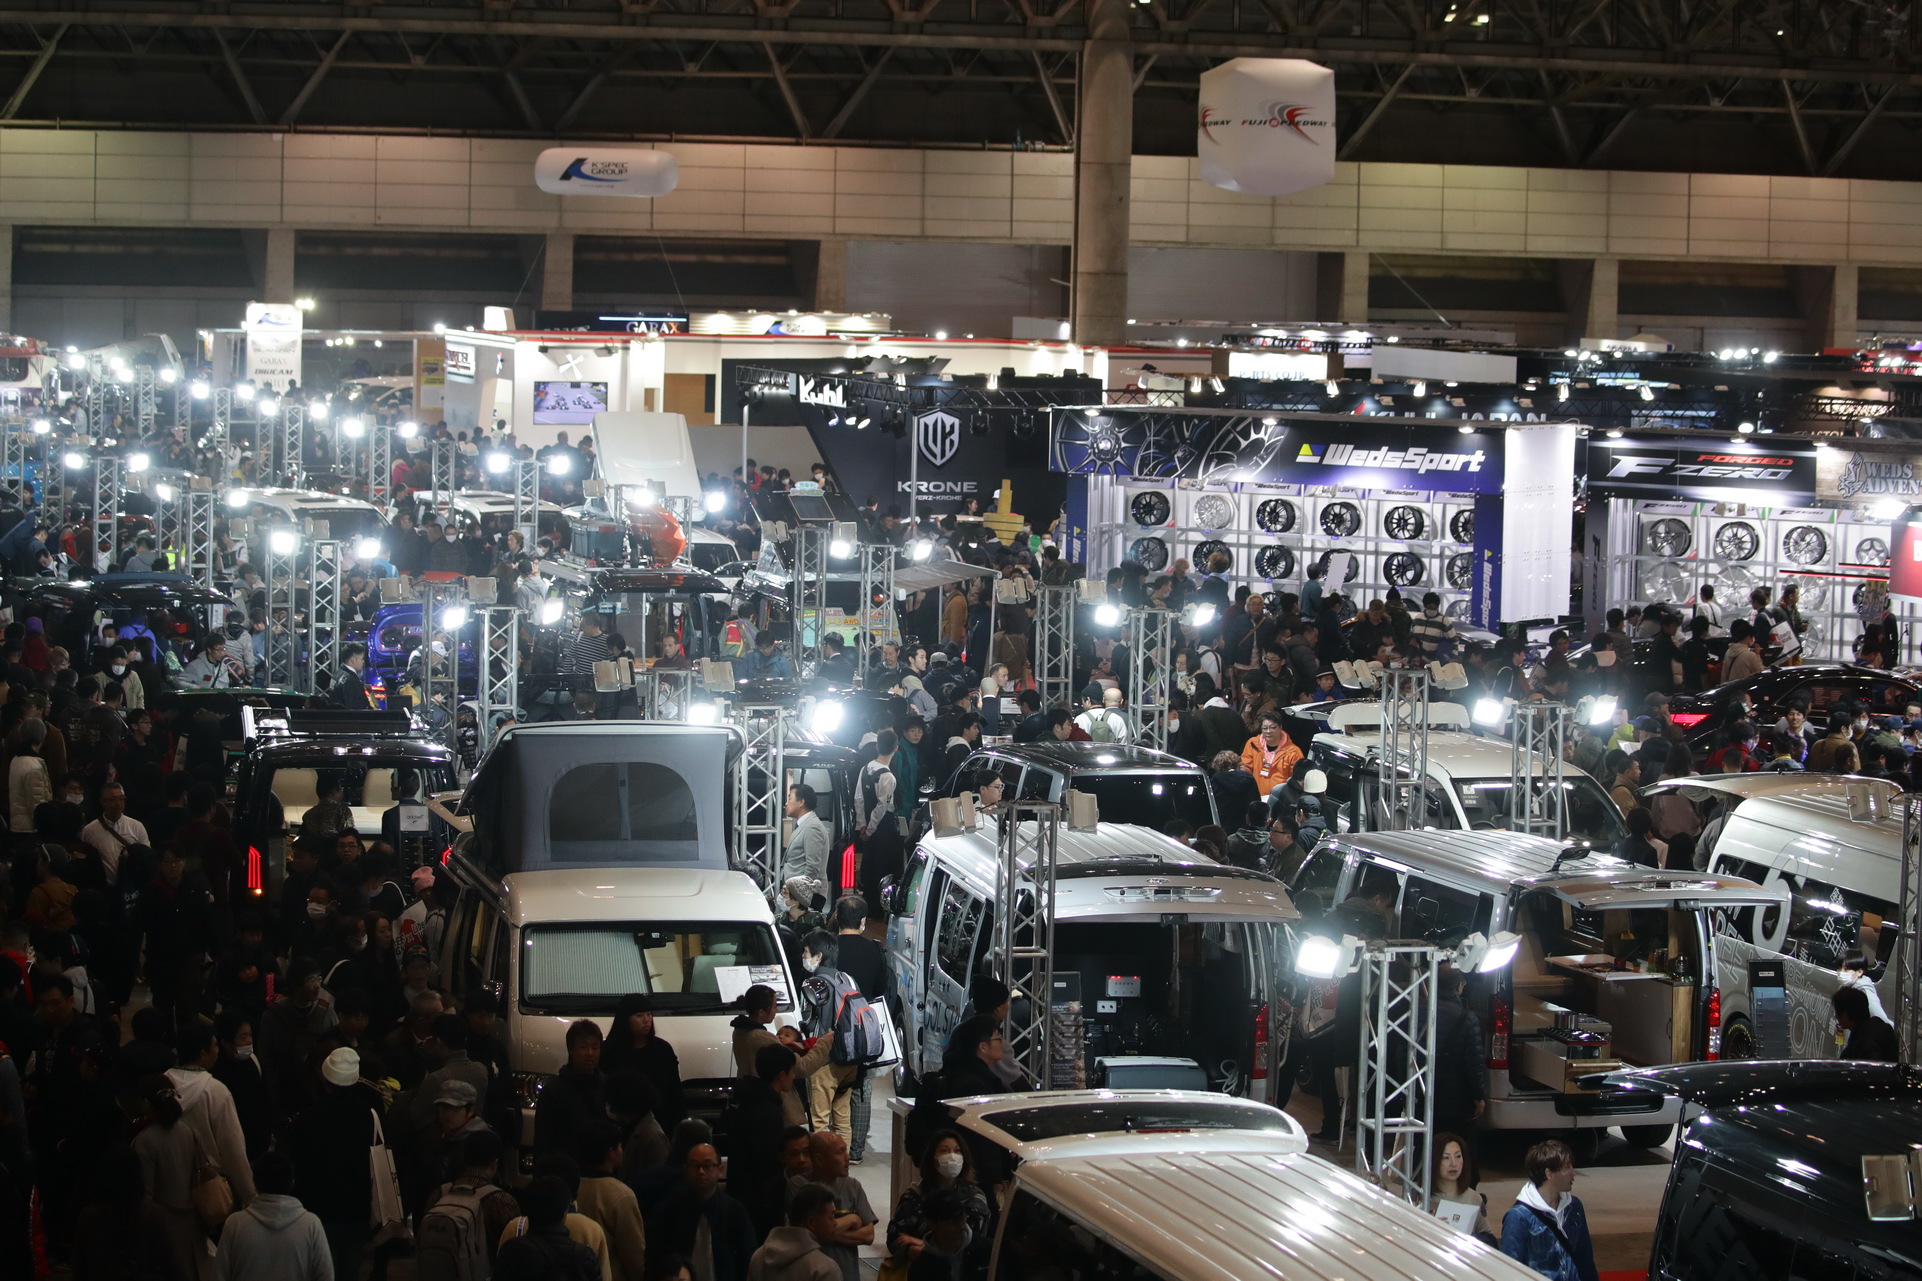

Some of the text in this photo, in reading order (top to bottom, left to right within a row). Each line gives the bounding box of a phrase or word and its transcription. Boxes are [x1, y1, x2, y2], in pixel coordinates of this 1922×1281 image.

[590, 168, 628, 176] GROUP
[626, 321, 680, 334] GARAX
[254, 368, 294, 376] DIGICAM
[1322, 443, 1486, 474] WedsSport
[1697, 454, 1794, 466] FORGED
[1606, 455, 1793, 480] F ZERO
[1864, 462, 1913, 479] WEDS
[897, 481, 978, 493] KRONE
